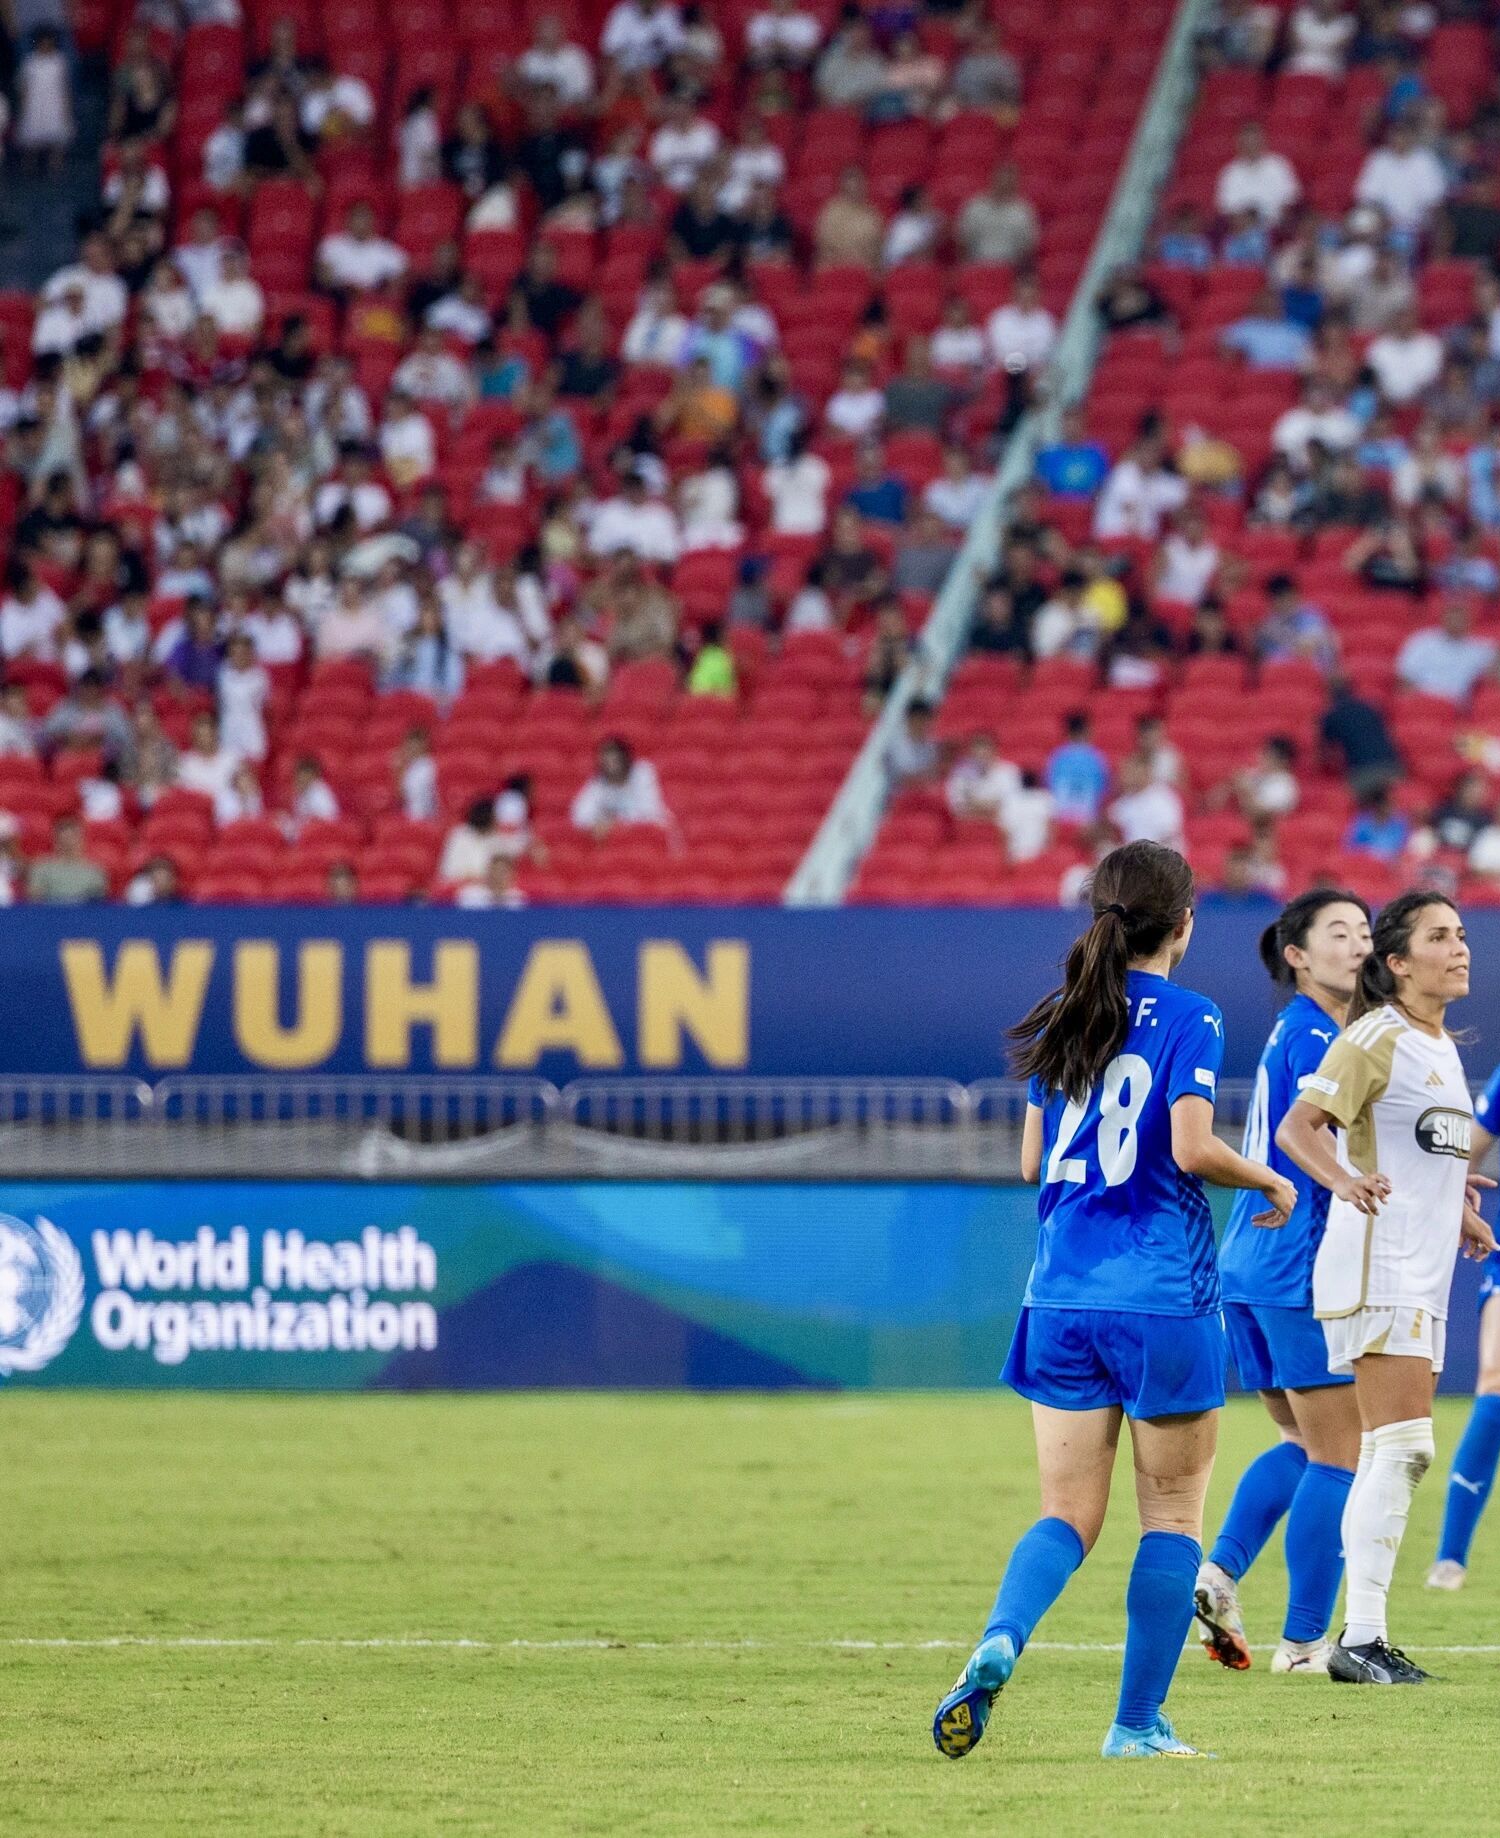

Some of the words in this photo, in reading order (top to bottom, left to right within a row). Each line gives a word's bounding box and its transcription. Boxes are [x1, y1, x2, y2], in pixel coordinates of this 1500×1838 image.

[59, 938, 752, 1069] WUHAN
[1045, 1053, 1153, 1187] 28
[92, 1225, 250, 1292] World
[263, 1225, 438, 1292] Health
[91, 1286, 438, 1366] Organization
